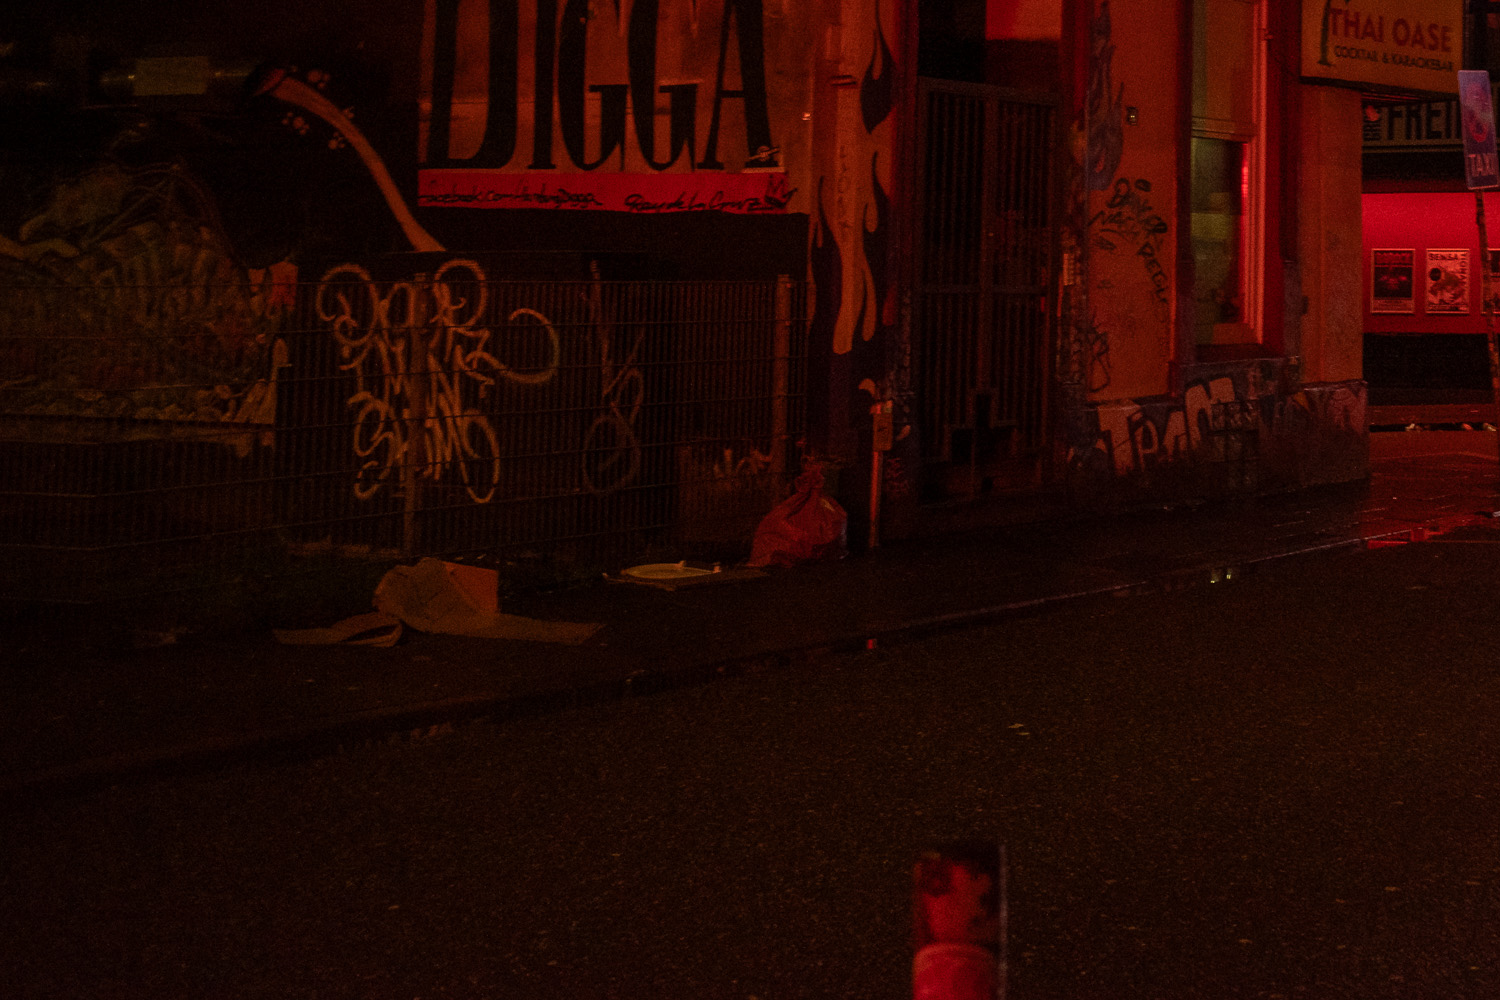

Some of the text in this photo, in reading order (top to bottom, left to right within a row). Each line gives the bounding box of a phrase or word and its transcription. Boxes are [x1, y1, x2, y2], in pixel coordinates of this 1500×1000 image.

[1330, 8, 1452, 52] THAI OASE
[1468, 153, 1496, 178] TAXI
